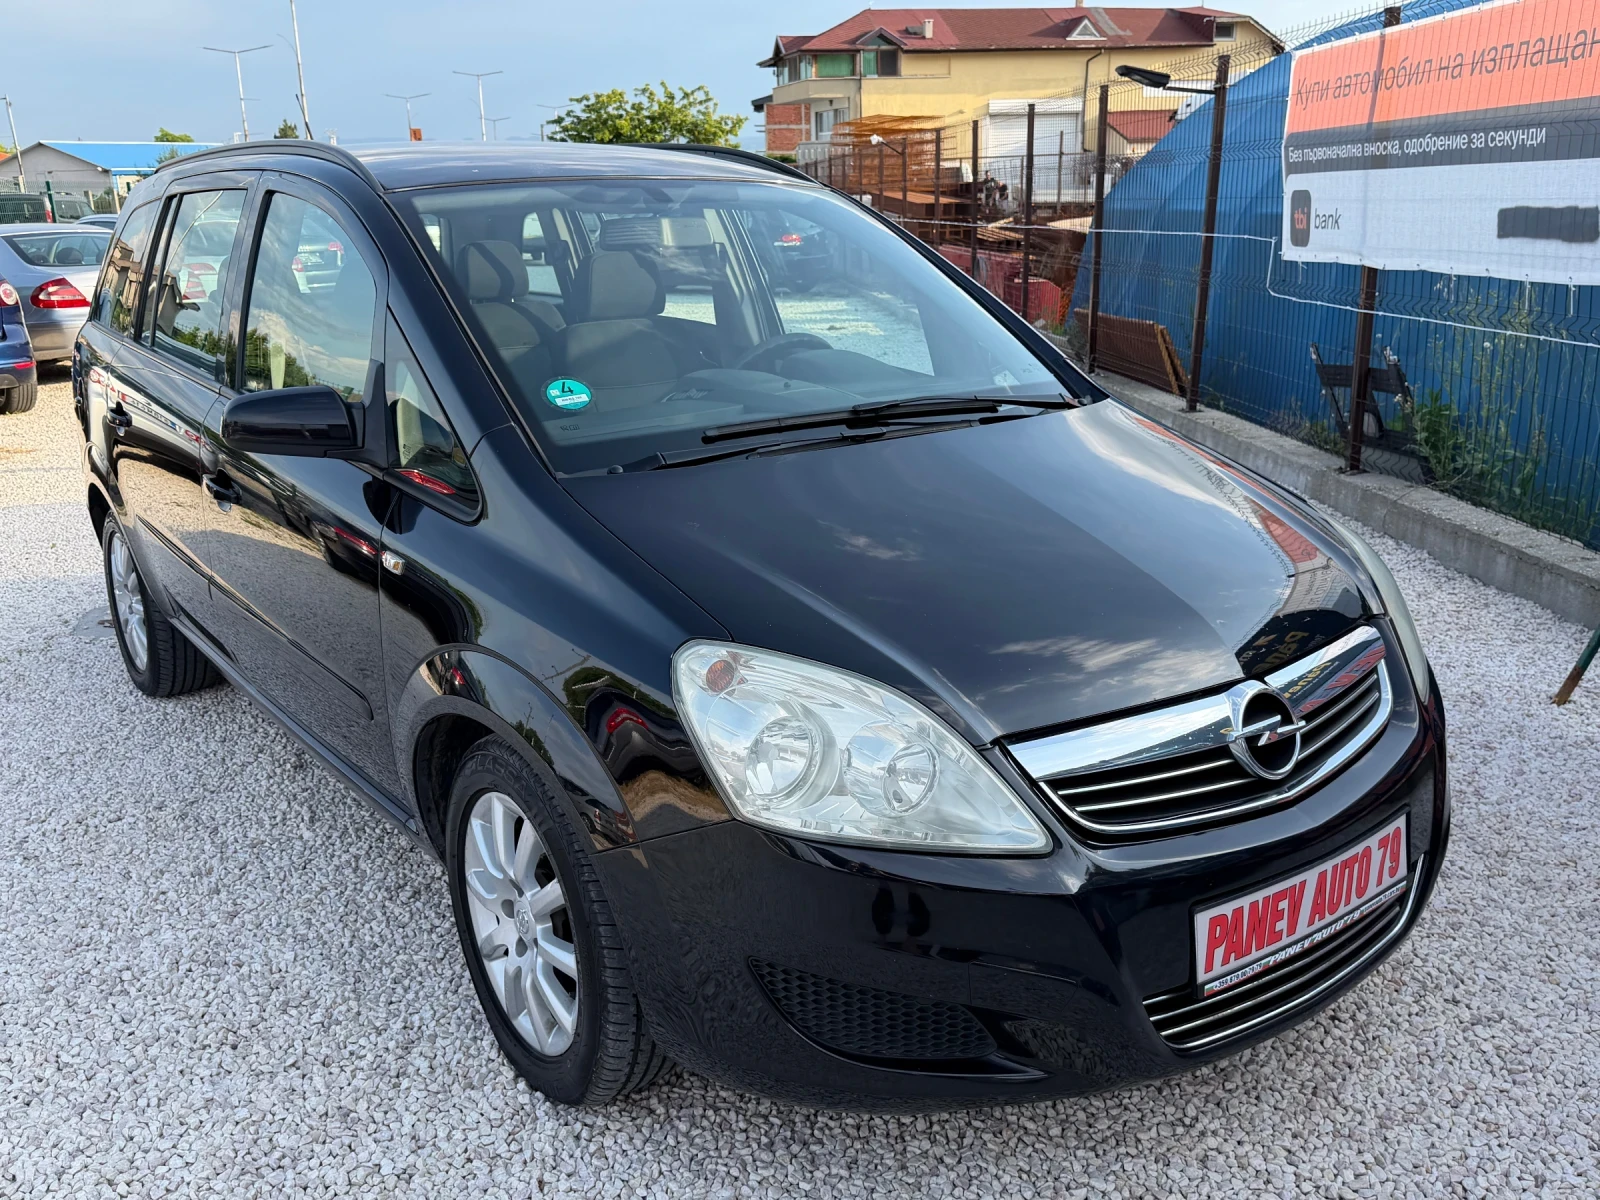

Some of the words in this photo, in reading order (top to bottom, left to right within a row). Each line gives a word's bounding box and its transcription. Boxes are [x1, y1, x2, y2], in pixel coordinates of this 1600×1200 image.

[1296, 77, 1330, 110] Купи
[1333, 56, 1433, 99] автомобил
[1437, 52, 1464, 81] на
[1288, 147, 1303, 163] Без
[1304, 143, 1363, 163] първоначална
[1364, 139, 1402, 157] вноска,
[1404, 133, 1469, 156] одобрение
[1470, 132, 1485, 149] за
[1488, 127, 1547, 150] секунди
[1294, 207, 1307, 229] tbi
[1314, 208, 1342, 230] bank
[561, 381, 574, 395] 4
[1204, 879, 1307, 974] PANEV
[1307, 845, 1372, 928] AUTO
[1376, 826, 1402, 888] 79
[1269, 937, 1311, 965] PANEV
[1312, 918, 1344, 943] AUTO
[1344, 909, 1361, 924] 79
